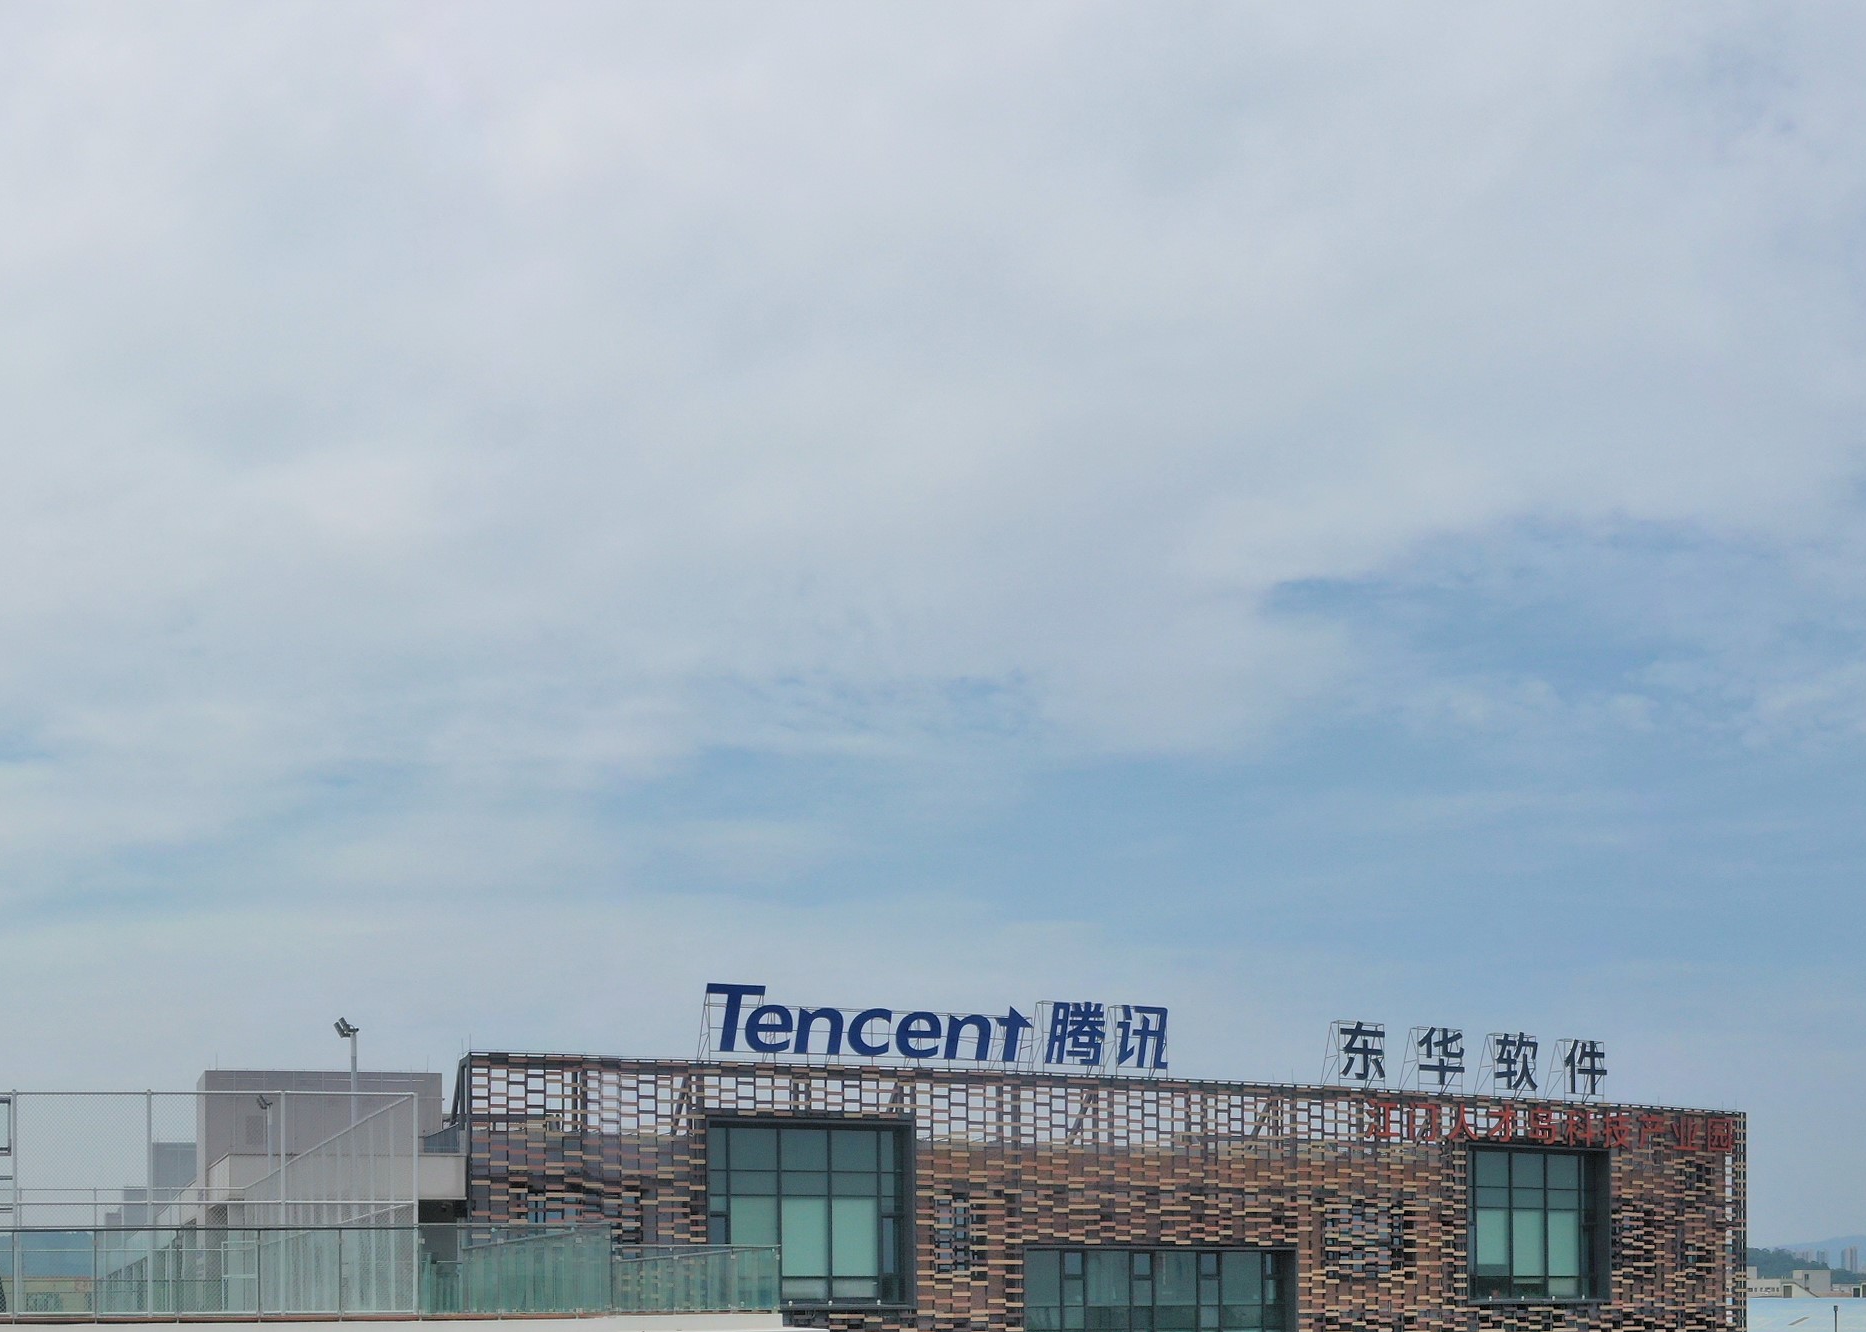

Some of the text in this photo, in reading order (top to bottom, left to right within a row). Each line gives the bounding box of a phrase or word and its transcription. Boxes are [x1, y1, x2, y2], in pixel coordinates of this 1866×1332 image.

[706, 982, 1169, 1070] Tencent 腾讯
[1339, 1021, 1608, 1095] 东华软件
[1366, 1099, 1736, 1153] 江门人才岛科技产业园
